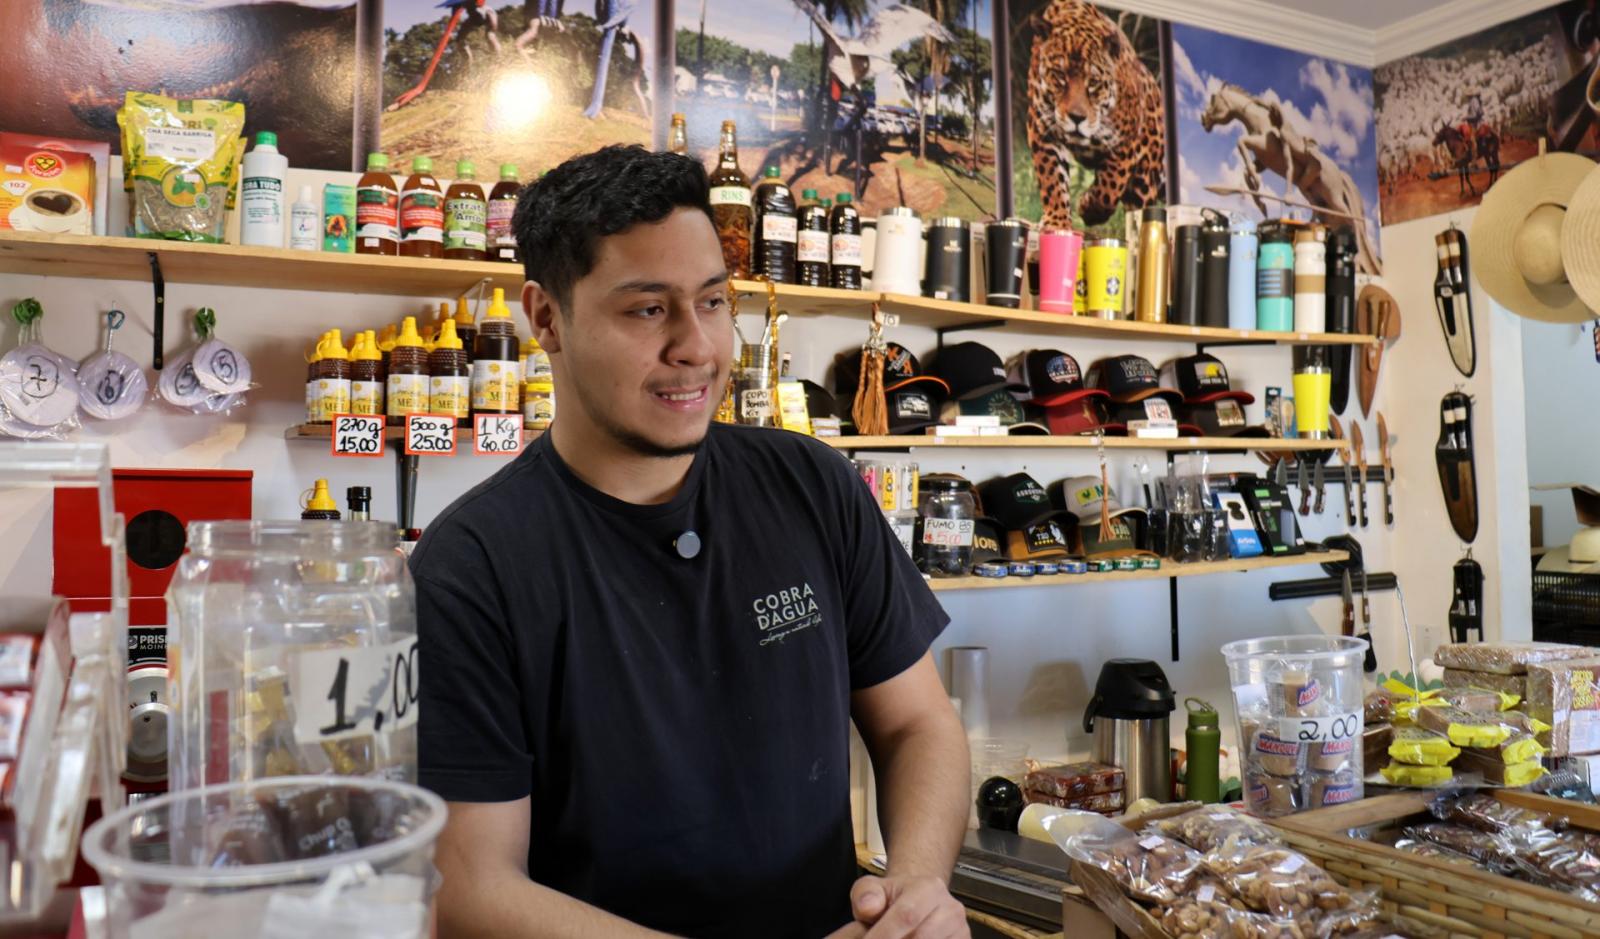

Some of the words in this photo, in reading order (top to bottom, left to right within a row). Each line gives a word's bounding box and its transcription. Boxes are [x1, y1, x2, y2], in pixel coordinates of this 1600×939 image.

[260, 181, 281, 191] TUDO
[720, 189, 744, 202] RINS
[218, 355, 233, 379] 5
[30, 363, 47, 391] 7
[746, 390, 767, 399] COPO
[339, 417, 367, 433] 270
[368, 422, 385, 440] g
[410, 417, 437, 431] 500
[477, 417, 493, 436] 1
[337, 435, 378, 453] 15,00
[926, 518, 955, 530] FUMO
[753, 582, 814, 614] COBRA
[756, 597, 819, 631] D'AGUA
[139, 635, 167, 644] PRIS
[319, 641, 418, 736] 1,00
[1298, 714, 1358, 741] 2,00
